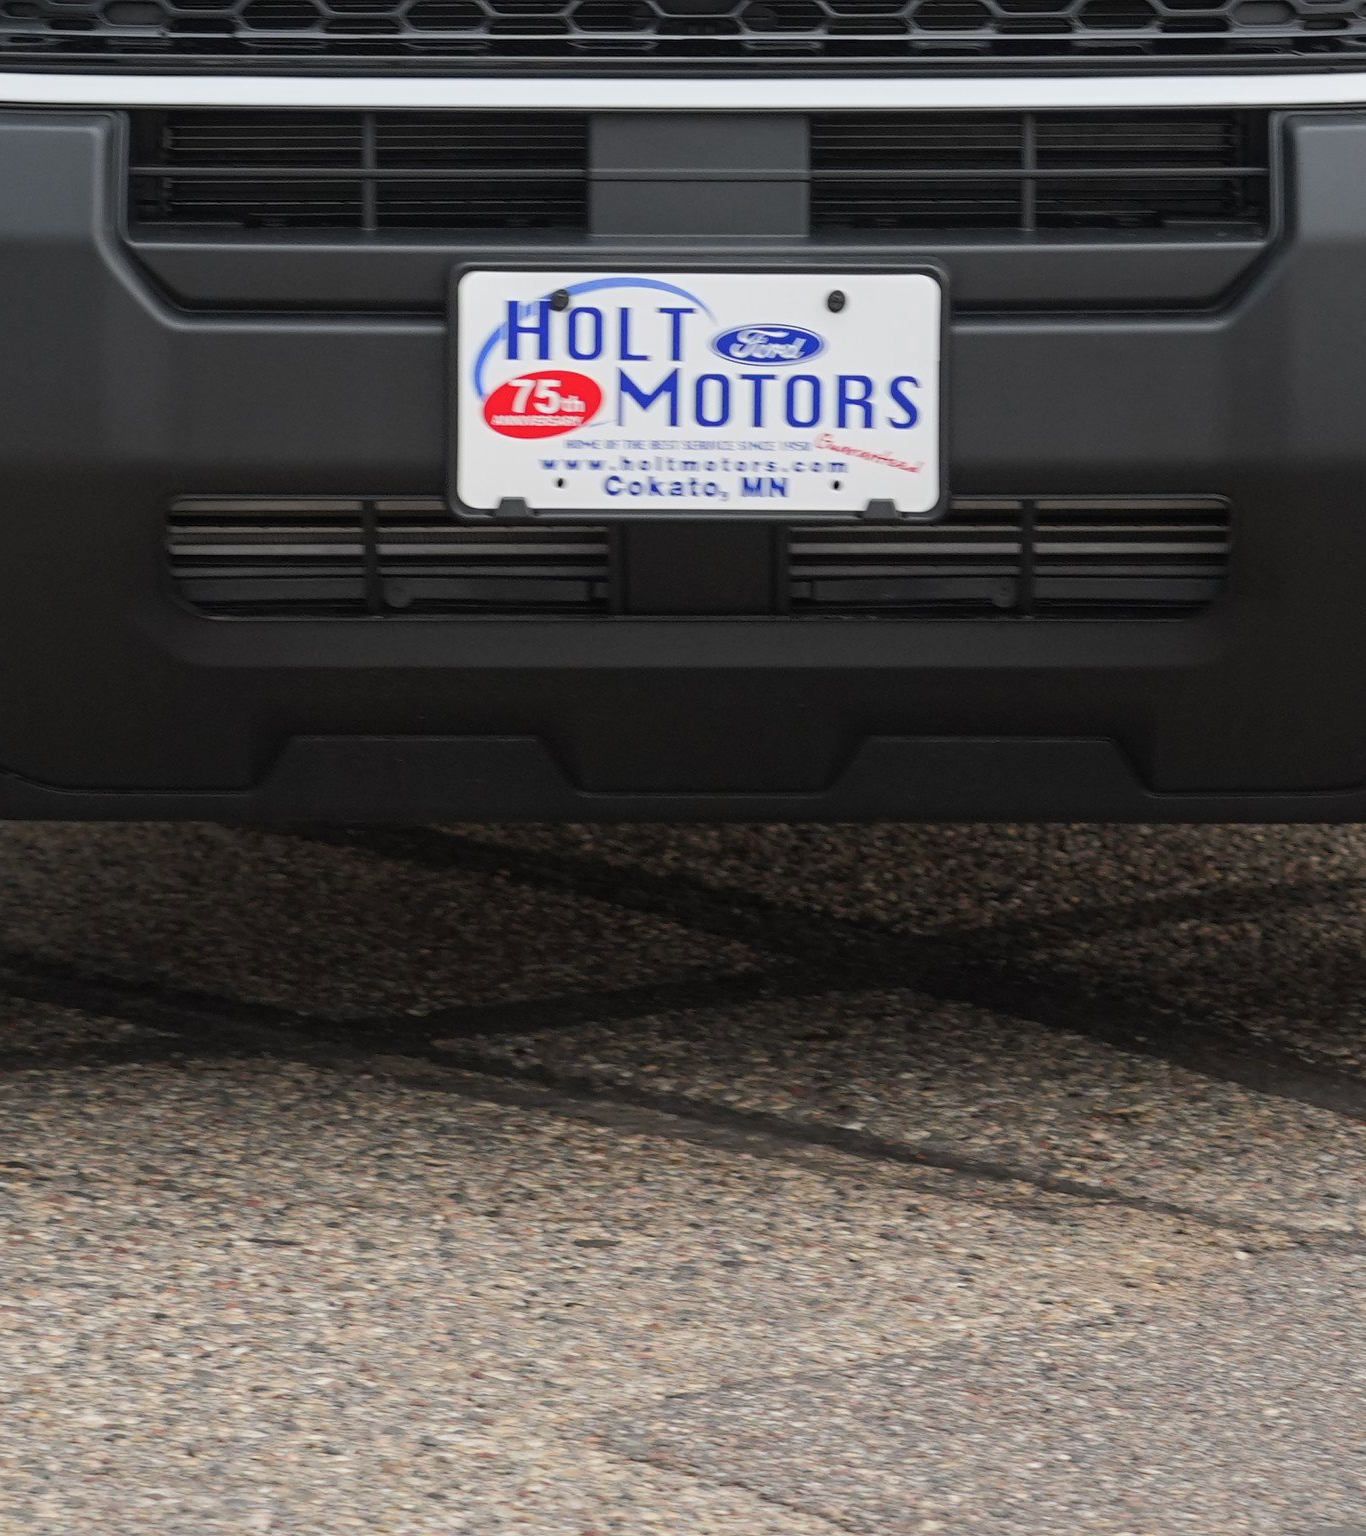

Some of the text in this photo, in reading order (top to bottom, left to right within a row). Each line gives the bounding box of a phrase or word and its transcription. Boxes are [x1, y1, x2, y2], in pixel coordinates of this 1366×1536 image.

[507, 300, 697, 361] HOLT
[508, 378, 586, 414] 75th
[618, 367, 921, 429] MOTORS
[539, 456, 848, 473] www.holtmotors.com
[604, 475, 788, 501] Cokato, MN
